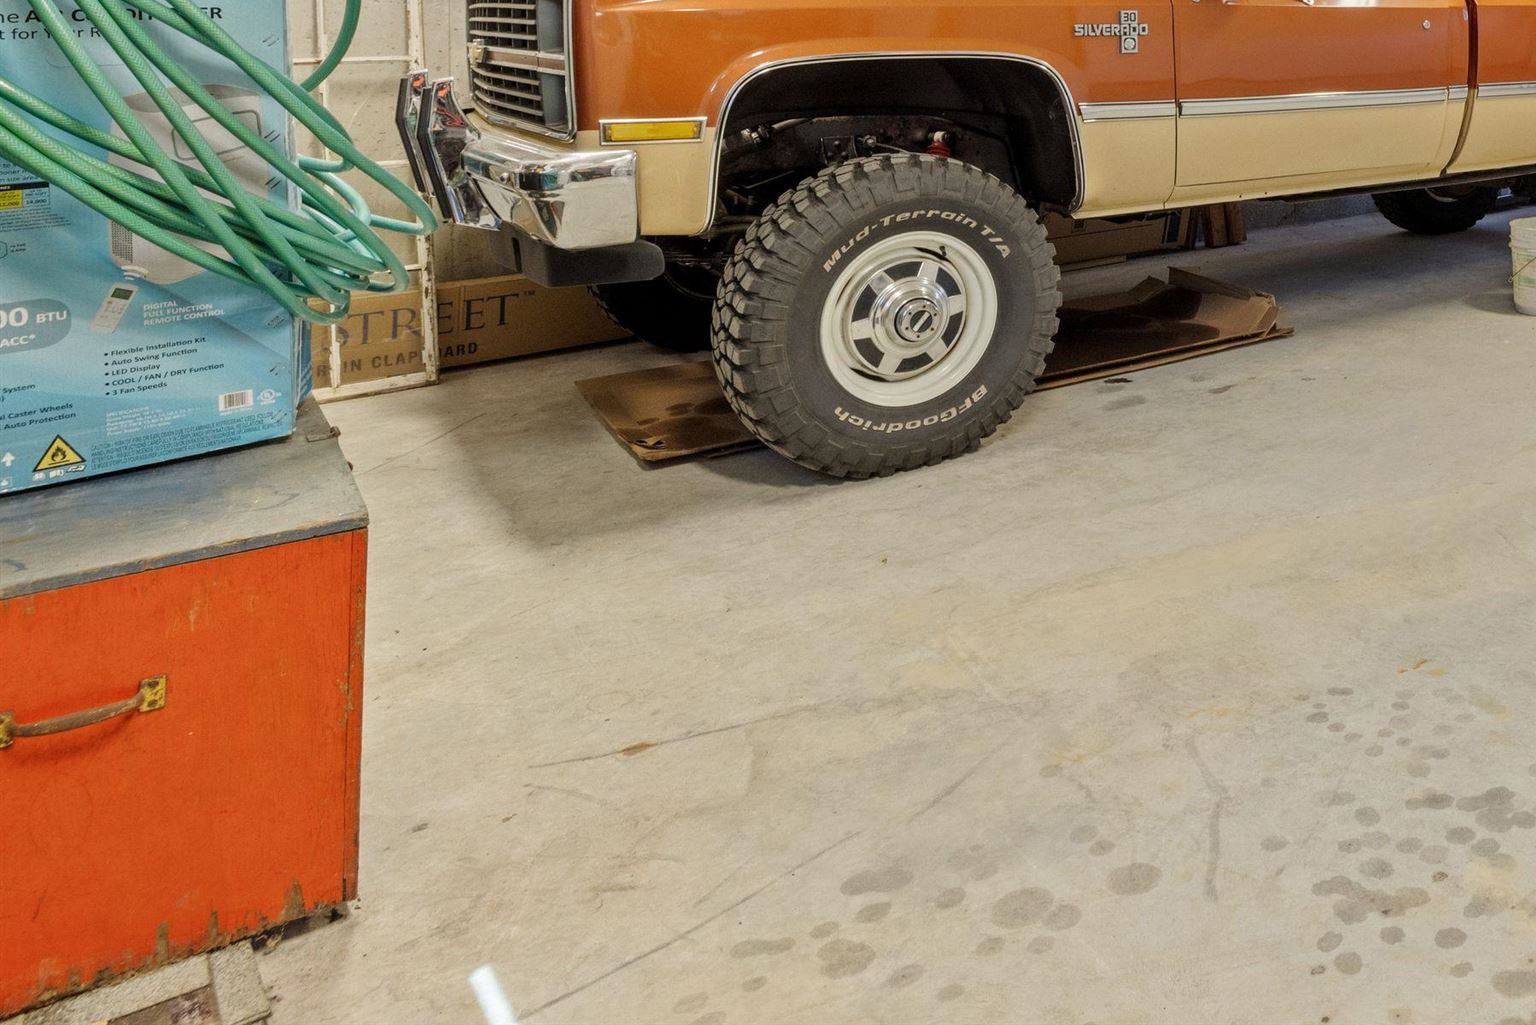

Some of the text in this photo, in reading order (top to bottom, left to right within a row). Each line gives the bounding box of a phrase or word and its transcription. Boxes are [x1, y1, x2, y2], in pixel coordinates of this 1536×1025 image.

[1123, 12, 1136, 22] 30
[12, 28, 37, 40] for
[1074, 23, 1149, 36] SILVERADO
[822, 208, 1011, 274] Mud-Terrain T/A
[143, 300, 177, 311] DIGITAL
[143, 303, 213, 319] FULL FUNCTION
[36, 310, 68, 324] BTU
[143, 308, 226, 326] REMOTE CONTROL
[111, 346, 144, 356] Flexible
[146, 338, 193, 351] Installation
[111, 347, 198, 366] Auto Swing Function
[371, 342, 478, 369] CLAPARD
[112, 363, 160, 376] LED Display
[112, 377, 135, 387] COOL
[145, 372, 161, 381] FAN
[170, 368, 188, 377] DRY
[189, 362, 225, 374] Function
[2, 384, 36, 394] System
[120, 386, 135, 395] Fan
[137, 381, 168, 392] Speeds
[8, 409, 37, 419] Caster
[39, 402, 73, 413] Wheels
[833, 383, 988, 434] BFGoodrich
[4, 412, 77, 430] Auto Protection
